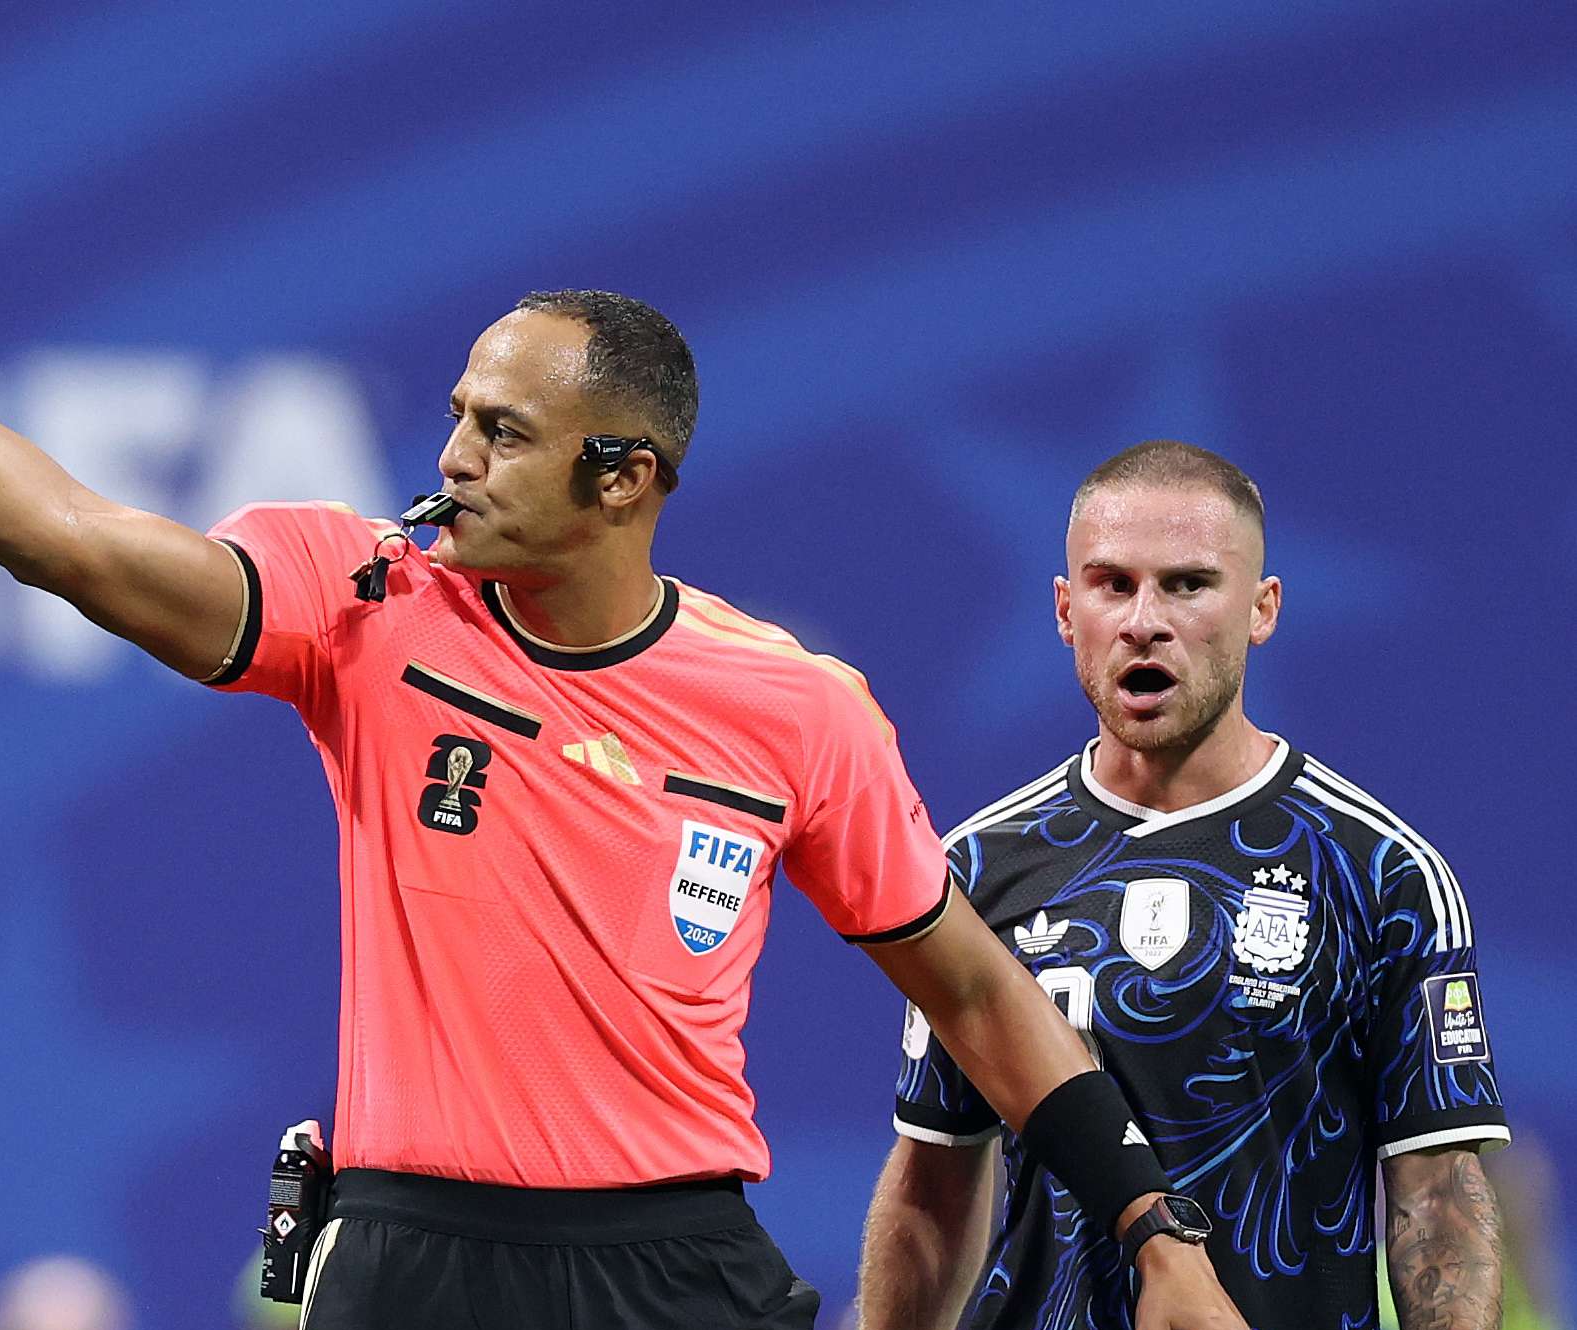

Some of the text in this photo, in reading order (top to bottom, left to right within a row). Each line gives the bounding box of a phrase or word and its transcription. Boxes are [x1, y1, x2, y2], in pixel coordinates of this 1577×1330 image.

[433, 811, 462, 828] FIFA
[689, 831, 753, 877] FIFA
[677, 879, 741, 912] REFEREE
[683, 925, 717, 946] 2026
[1140, 936, 1168, 945] FIFA
[1251, 910, 1291, 947] AFA
